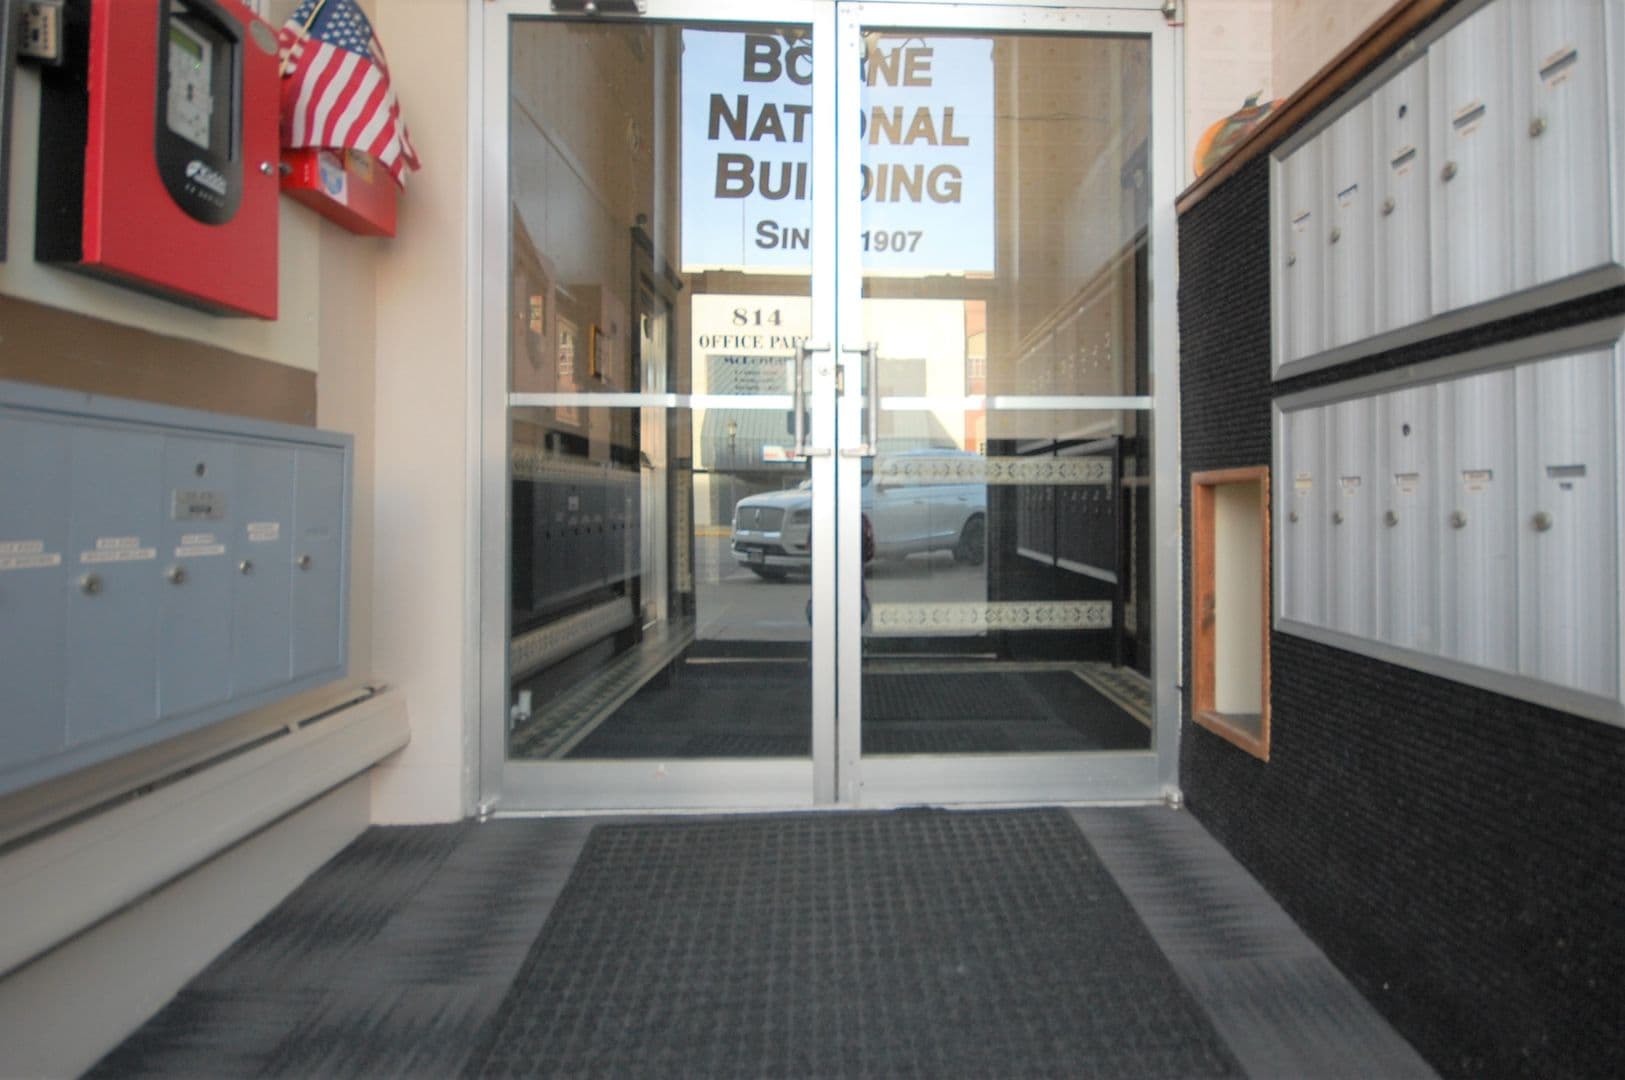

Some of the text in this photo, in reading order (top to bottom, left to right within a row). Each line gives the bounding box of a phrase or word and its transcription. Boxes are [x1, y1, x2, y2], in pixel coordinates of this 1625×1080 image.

[743, 33, 934, 86] BONE
[707, 93, 970, 146] NATNAL
[714, 152, 963, 203] BUIING
[755, 219, 923, 252] SIN 1907
[733, 307, 782, 327] 814
[699, 334, 764, 350] OFFICE
